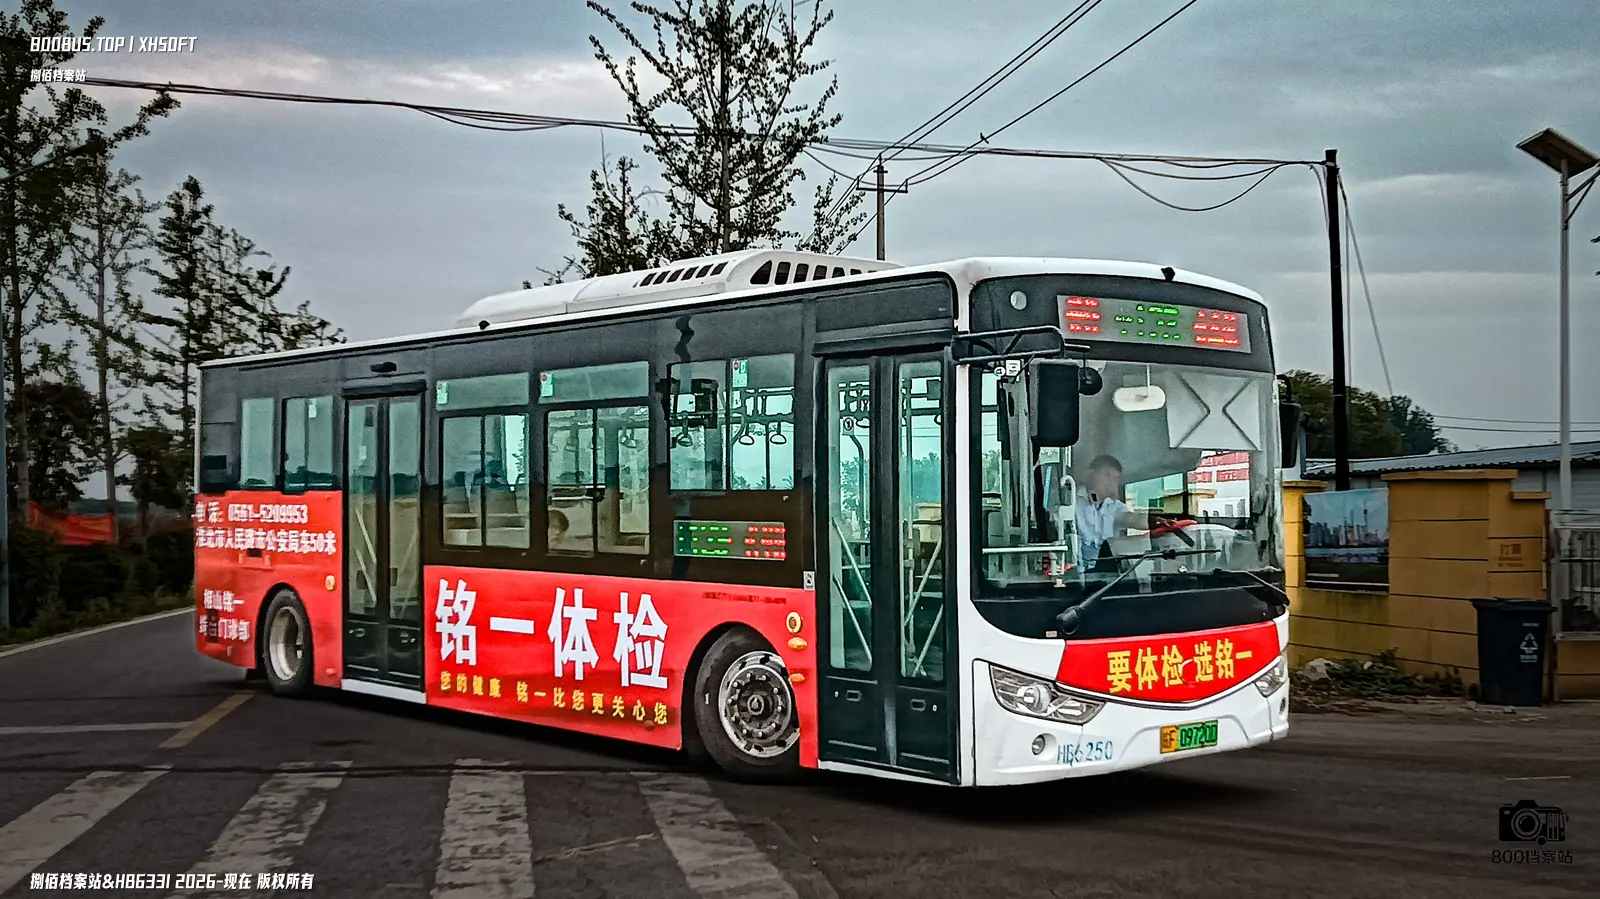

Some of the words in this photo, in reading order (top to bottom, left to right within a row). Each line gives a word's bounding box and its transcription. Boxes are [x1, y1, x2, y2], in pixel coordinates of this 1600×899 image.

[435, 578, 669, 690] 铭一体检
[1106, 644, 1184, 694] 要体检
[1193, 637, 1253, 682] 选铭一
[440, 670, 502, 698] 您的健康
[516, 680, 669, 725] 铭一比您更关心您
